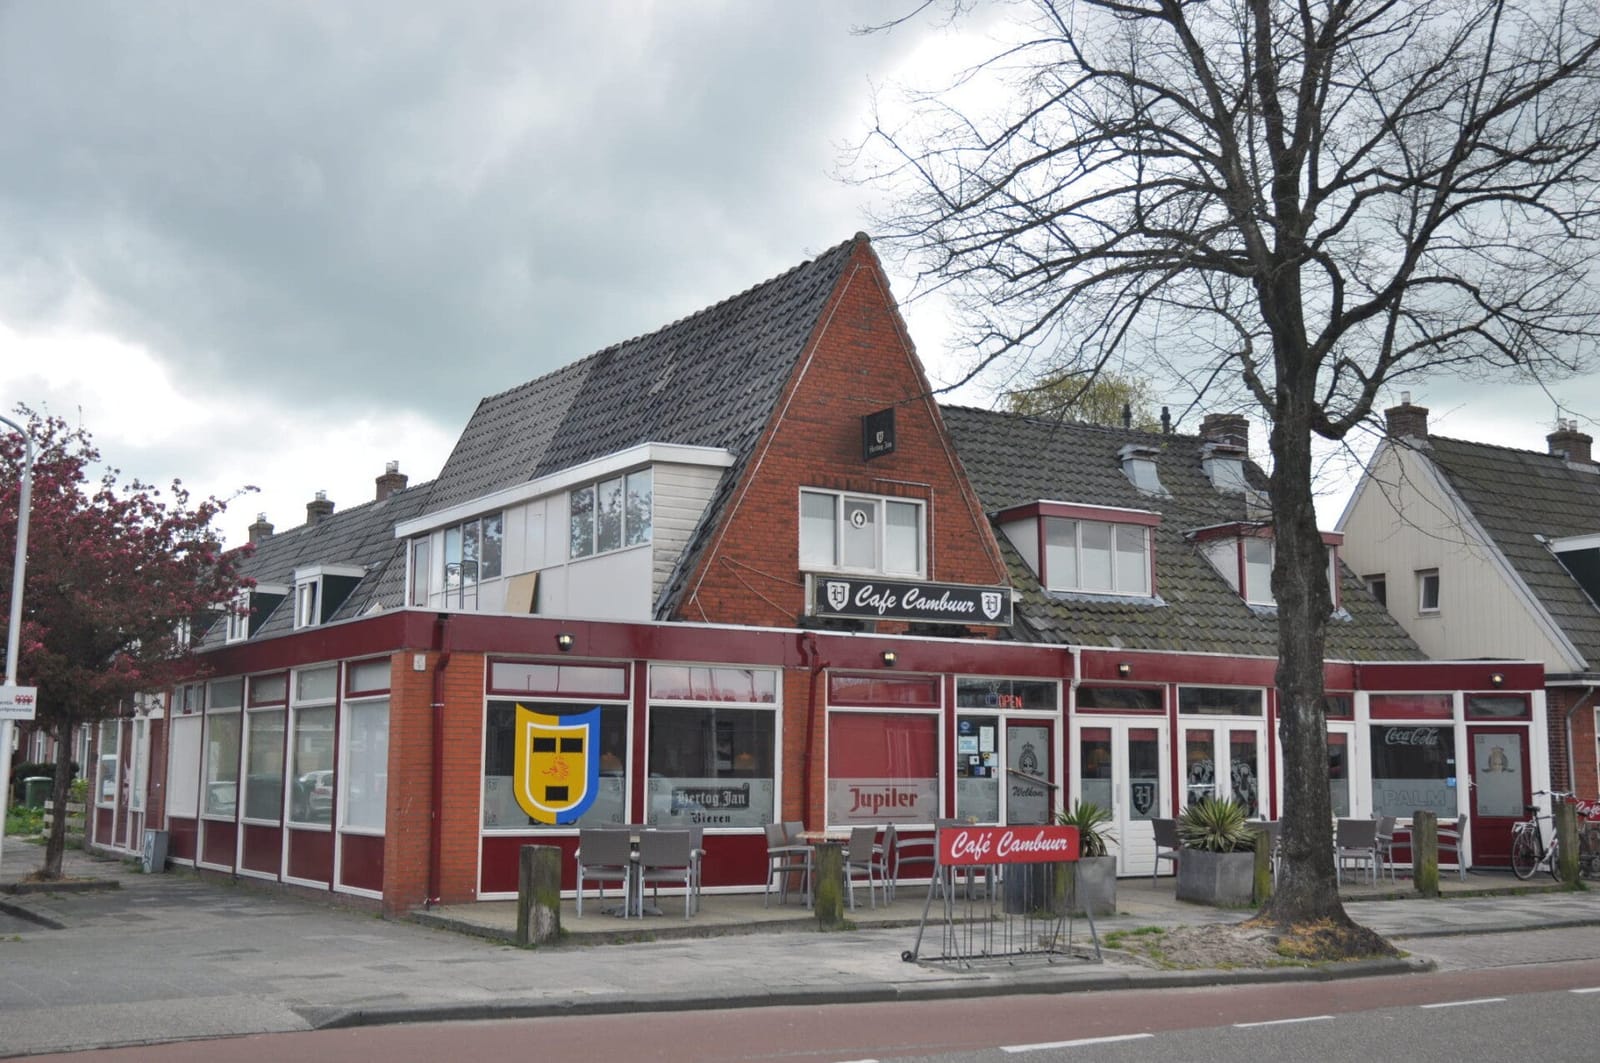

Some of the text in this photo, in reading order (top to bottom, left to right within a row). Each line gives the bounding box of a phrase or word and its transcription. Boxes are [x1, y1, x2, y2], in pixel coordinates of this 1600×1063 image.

[855, 585, 976, 615] Cafe Cambuur
[999, 695, 1024, 708] OPEN
[676, 790, 746, 807] Hertog Jan
[849, 788, 918, 815] Jupiler
[1383, 790, 1446, 807] PALM
[951, 830, 1068, 861] Café Cambuur
